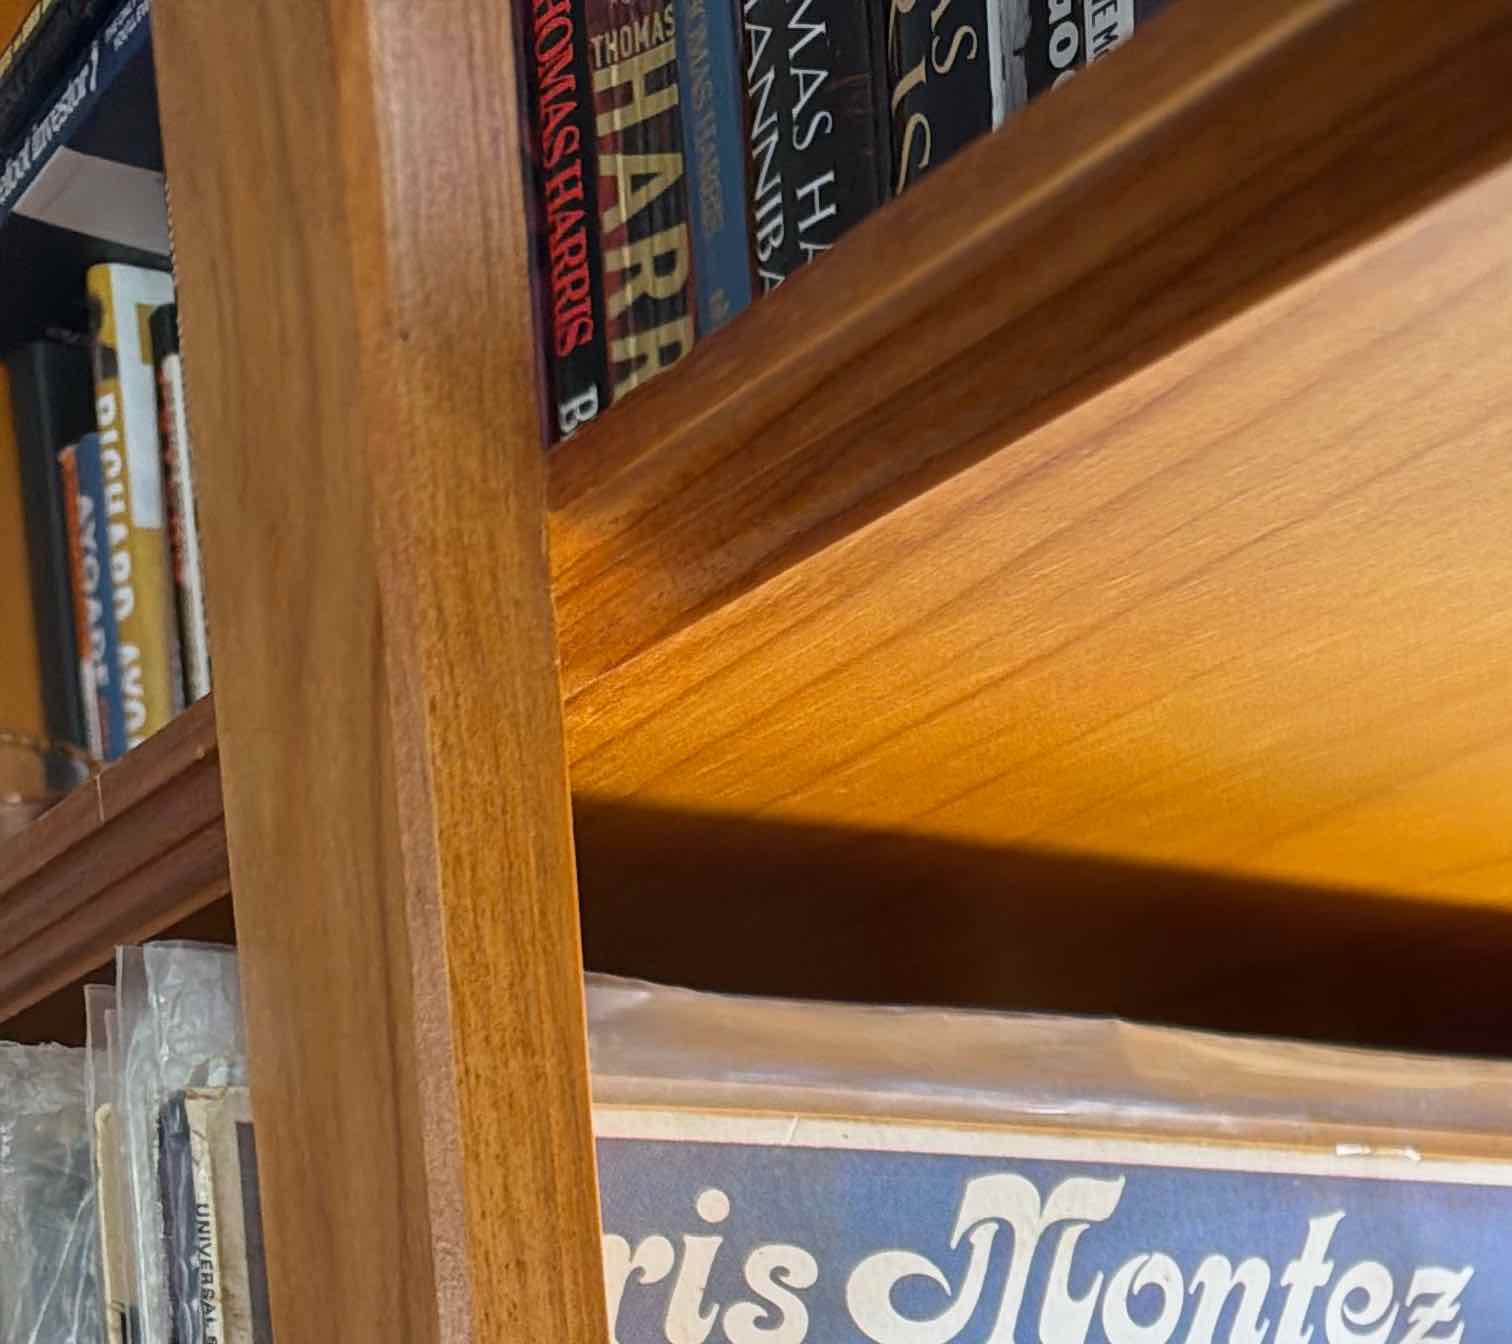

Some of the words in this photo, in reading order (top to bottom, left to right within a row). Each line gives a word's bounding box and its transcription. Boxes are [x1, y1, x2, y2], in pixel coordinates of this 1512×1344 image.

[590, 4, 675, 68] THOMAS
[546, 158, 594, 358] HARRIS
[195, 1203, 218, 1326] UNIVERSAL
